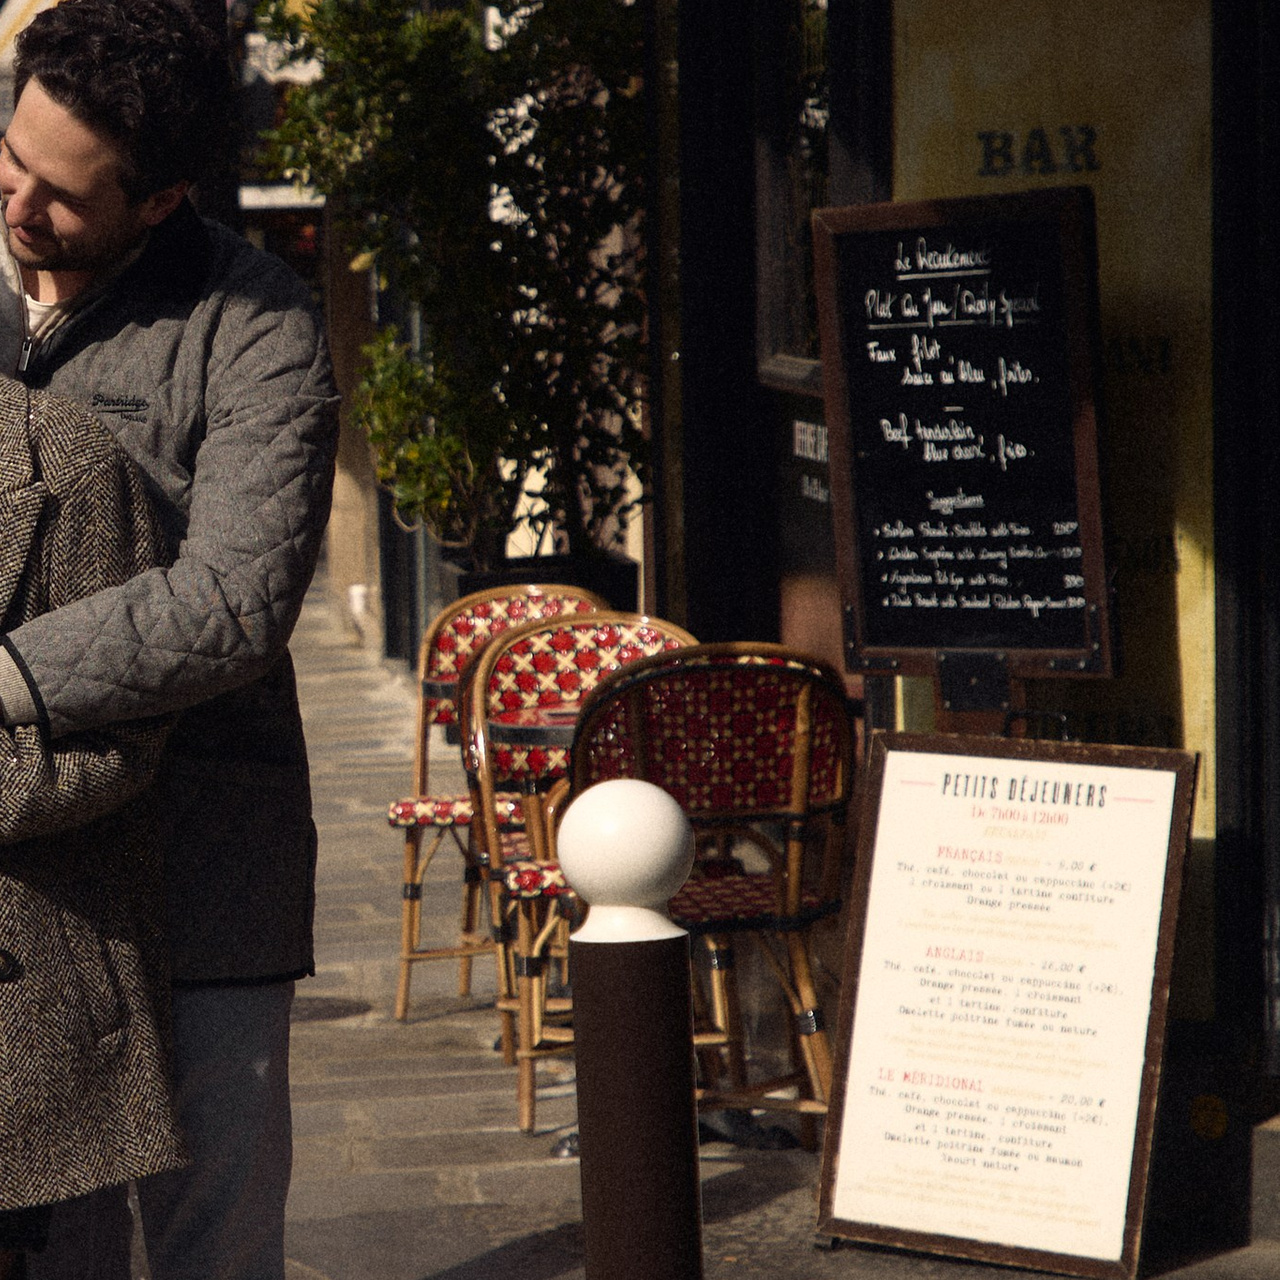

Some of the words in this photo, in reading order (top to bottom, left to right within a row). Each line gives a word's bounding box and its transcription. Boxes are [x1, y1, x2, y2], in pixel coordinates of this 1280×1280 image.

[977, 125, 1100, 176] BAR
[941, 772, 999, 799] PETITS
[1007, 774, 1108, 808] DÉJEUNERS
[936, 845, 1004, 866] FRANÇAIS
[966, 895, 1002, 909] Orange
[925, 945, 984, 962] ANGLAIS
[919, 977, 954, 992] Orange
[877, 1067, 895, 1081] LE
[904, 1104, 940, 1119] Orange
